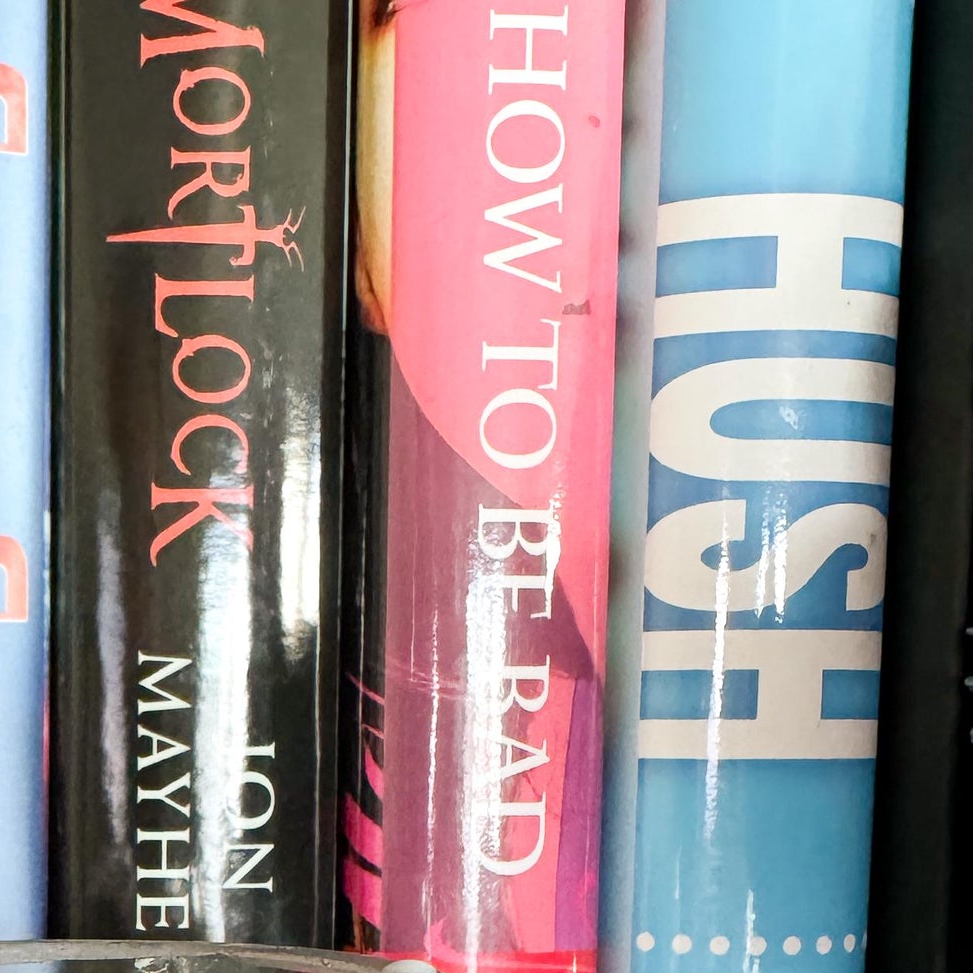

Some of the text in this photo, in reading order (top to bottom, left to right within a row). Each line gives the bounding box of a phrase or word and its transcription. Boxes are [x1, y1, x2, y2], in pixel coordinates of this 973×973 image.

[473, 4, 569, 877] HOW TO BE BAD
[637, 192, 904, 761] HUSH
